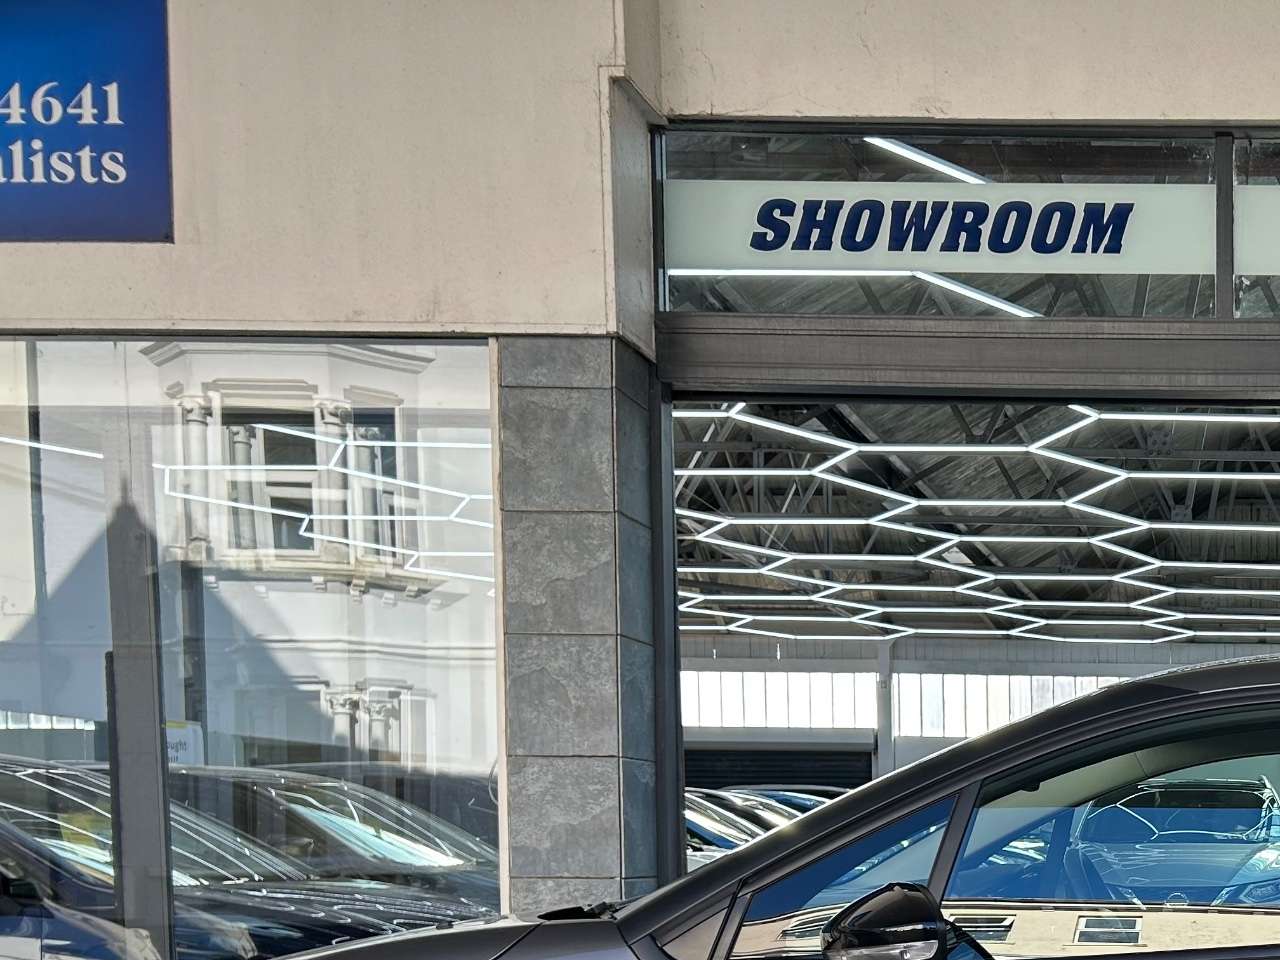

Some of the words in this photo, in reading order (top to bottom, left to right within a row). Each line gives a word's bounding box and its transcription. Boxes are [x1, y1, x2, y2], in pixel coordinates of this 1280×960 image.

[0, 81, 125, 125] 4641
[0, 138, 127, 184] lists
[749, 198, 1135, 255] SHOWROOM
